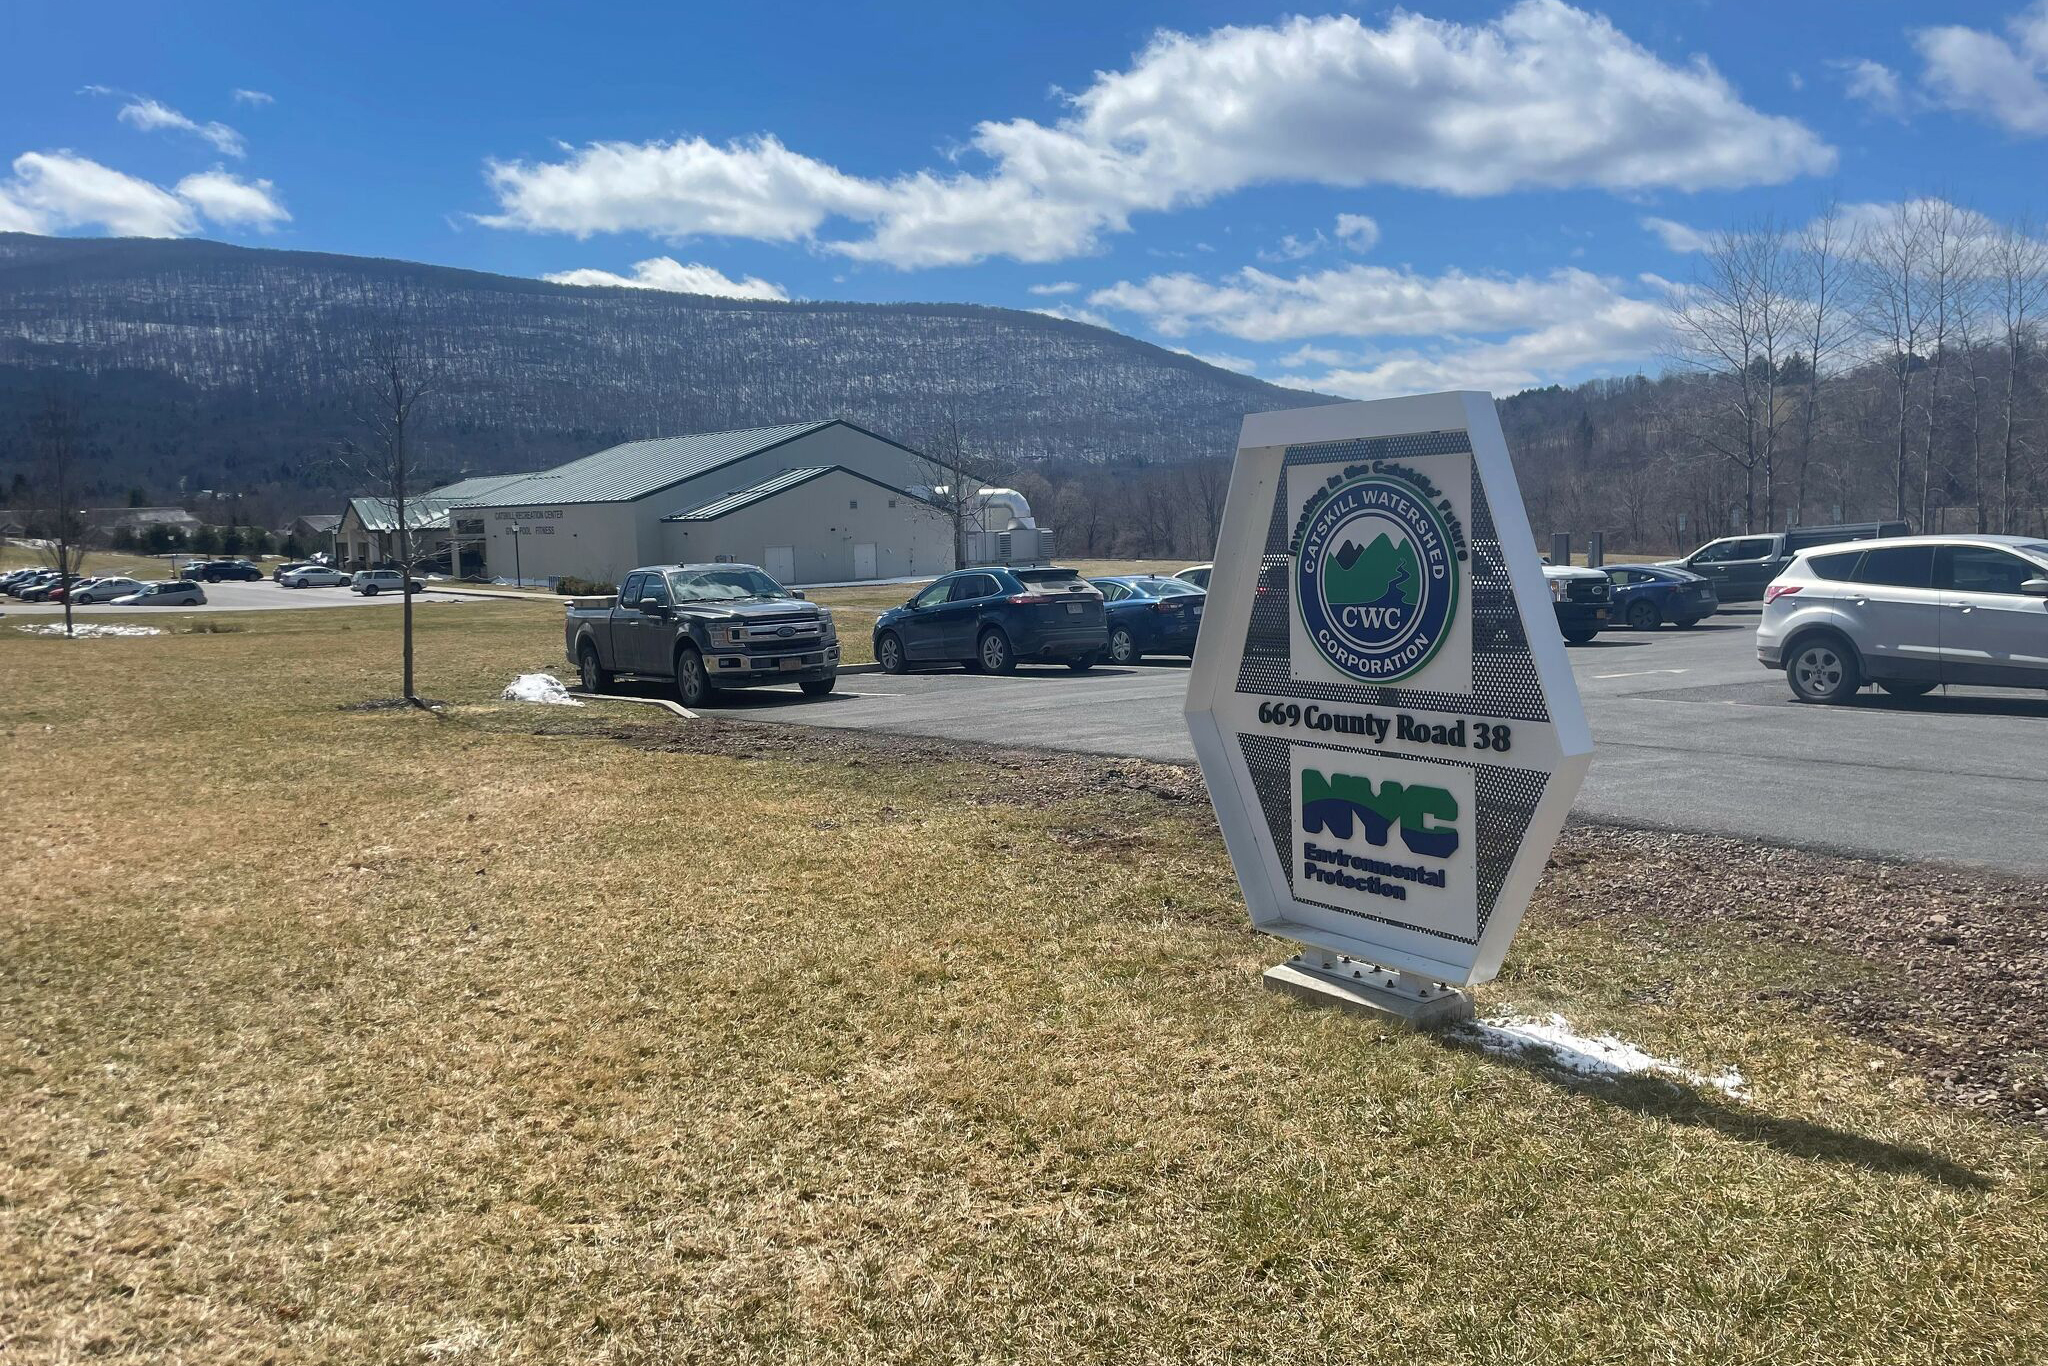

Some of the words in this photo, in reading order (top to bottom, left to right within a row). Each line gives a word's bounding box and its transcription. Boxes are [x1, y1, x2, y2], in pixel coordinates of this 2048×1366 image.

[495, 512, 514, 520] CATSKILL
[515, 510, 544, 520] RECREATION
[545, 510, 563, 519] CENTER
[535, 526, 555, 535] FITNESS
[1304, 495, 1358, 574] CATSKILL
[1362, 490, 1445, 580] WATERSHED
[1342, 606, 1401, 629] CWC
[1318, 629, 1430, 674] CORPORATION
[1258, 702, 1301, 727] 669
[1303, 705, 1390, 743] County
[1396, 714, 1467, 748] Road
[1472, 722, 1512, 752] 38
[1301, 768, 1459, 858] NYC
[1303, 842, 1446, 888] Environmental
[1304, 862, 1407, 901] Protection
